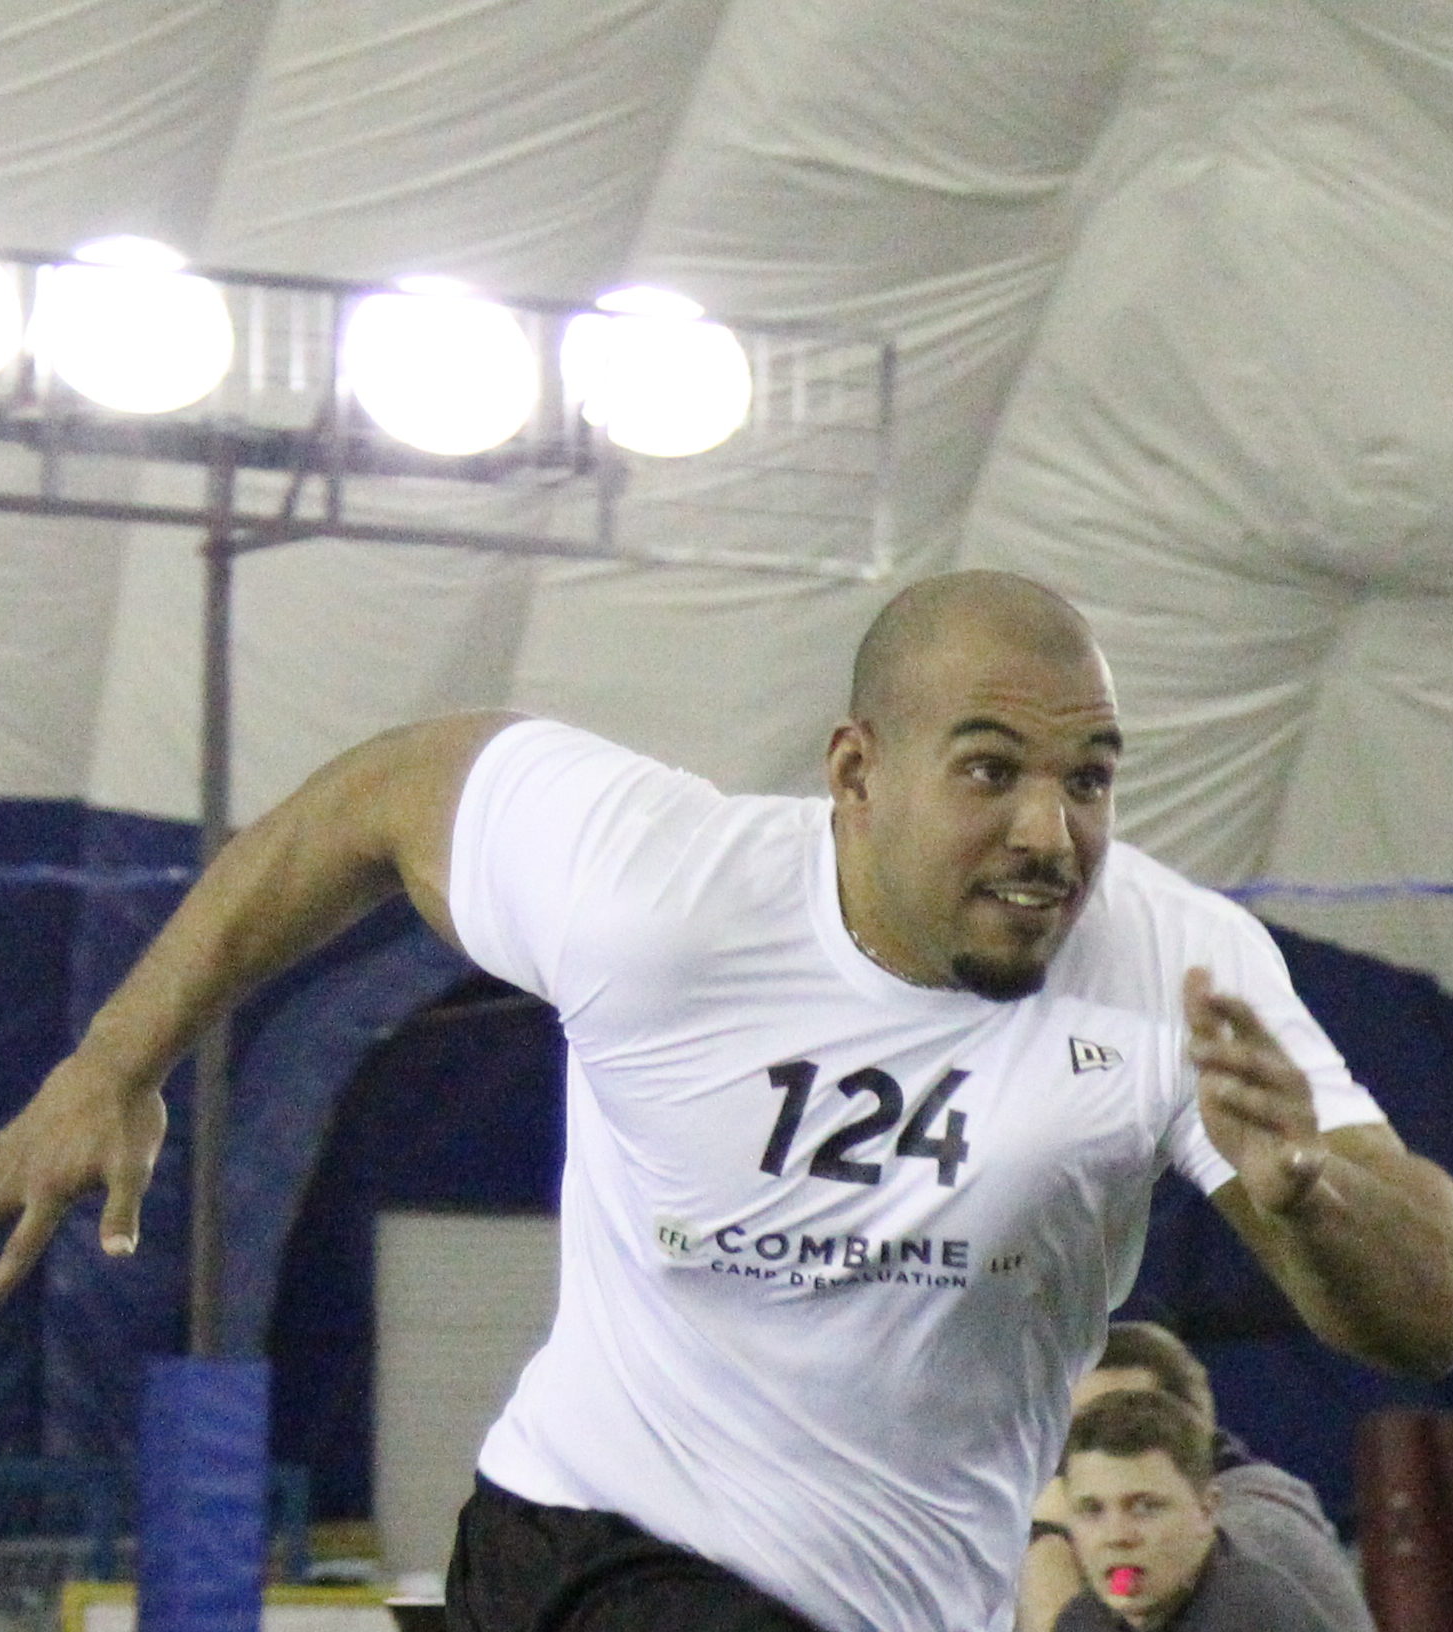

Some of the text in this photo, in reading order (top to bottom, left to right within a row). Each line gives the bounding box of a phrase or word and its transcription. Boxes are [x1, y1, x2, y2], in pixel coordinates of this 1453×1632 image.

[758, 1060, 972, 1188] 124
[710, 1258, 778, 1280] CAMP
[715, 1224, 969, 1270] COMBINE
